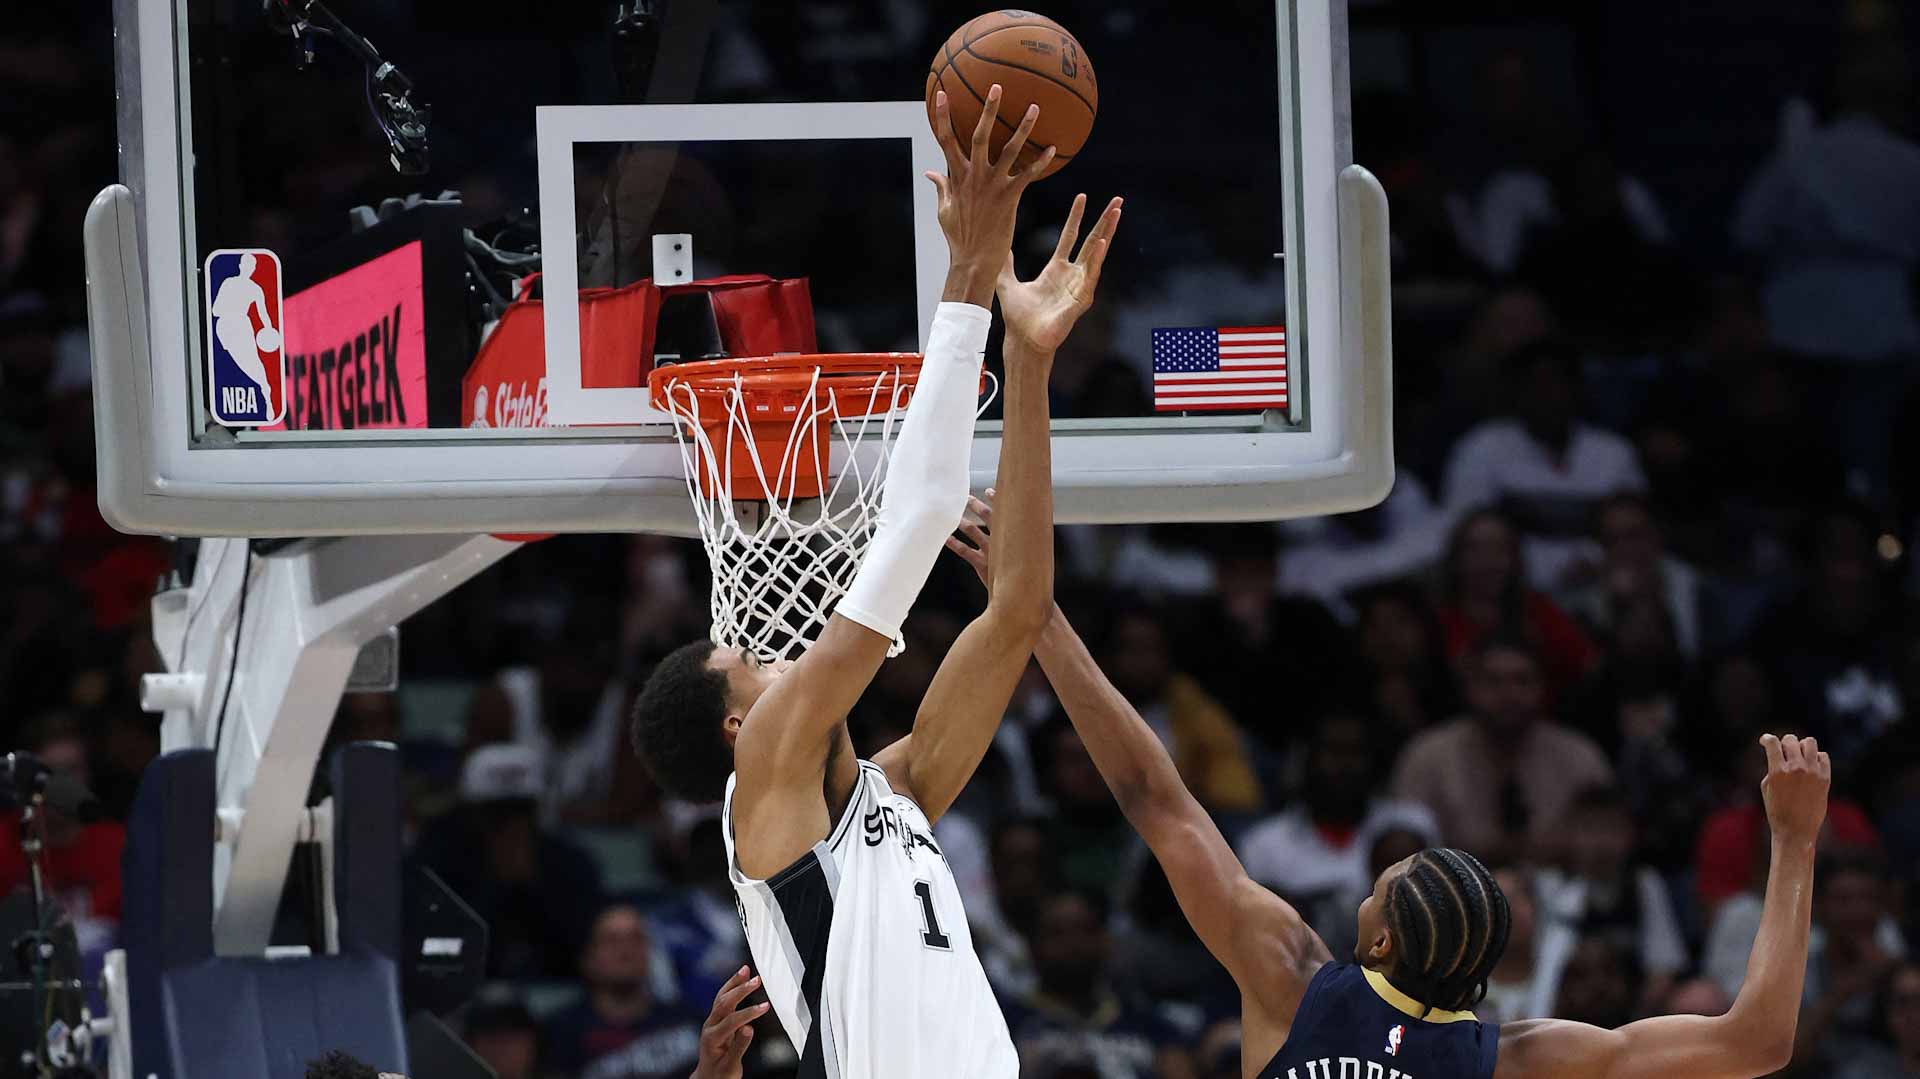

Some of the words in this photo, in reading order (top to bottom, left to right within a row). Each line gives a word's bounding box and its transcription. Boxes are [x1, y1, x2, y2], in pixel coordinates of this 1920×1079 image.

[222, 386, 258, 414] NBA
[285, 304, 406, 429] EATGEEK
[914, 879, 952, 951] 1
